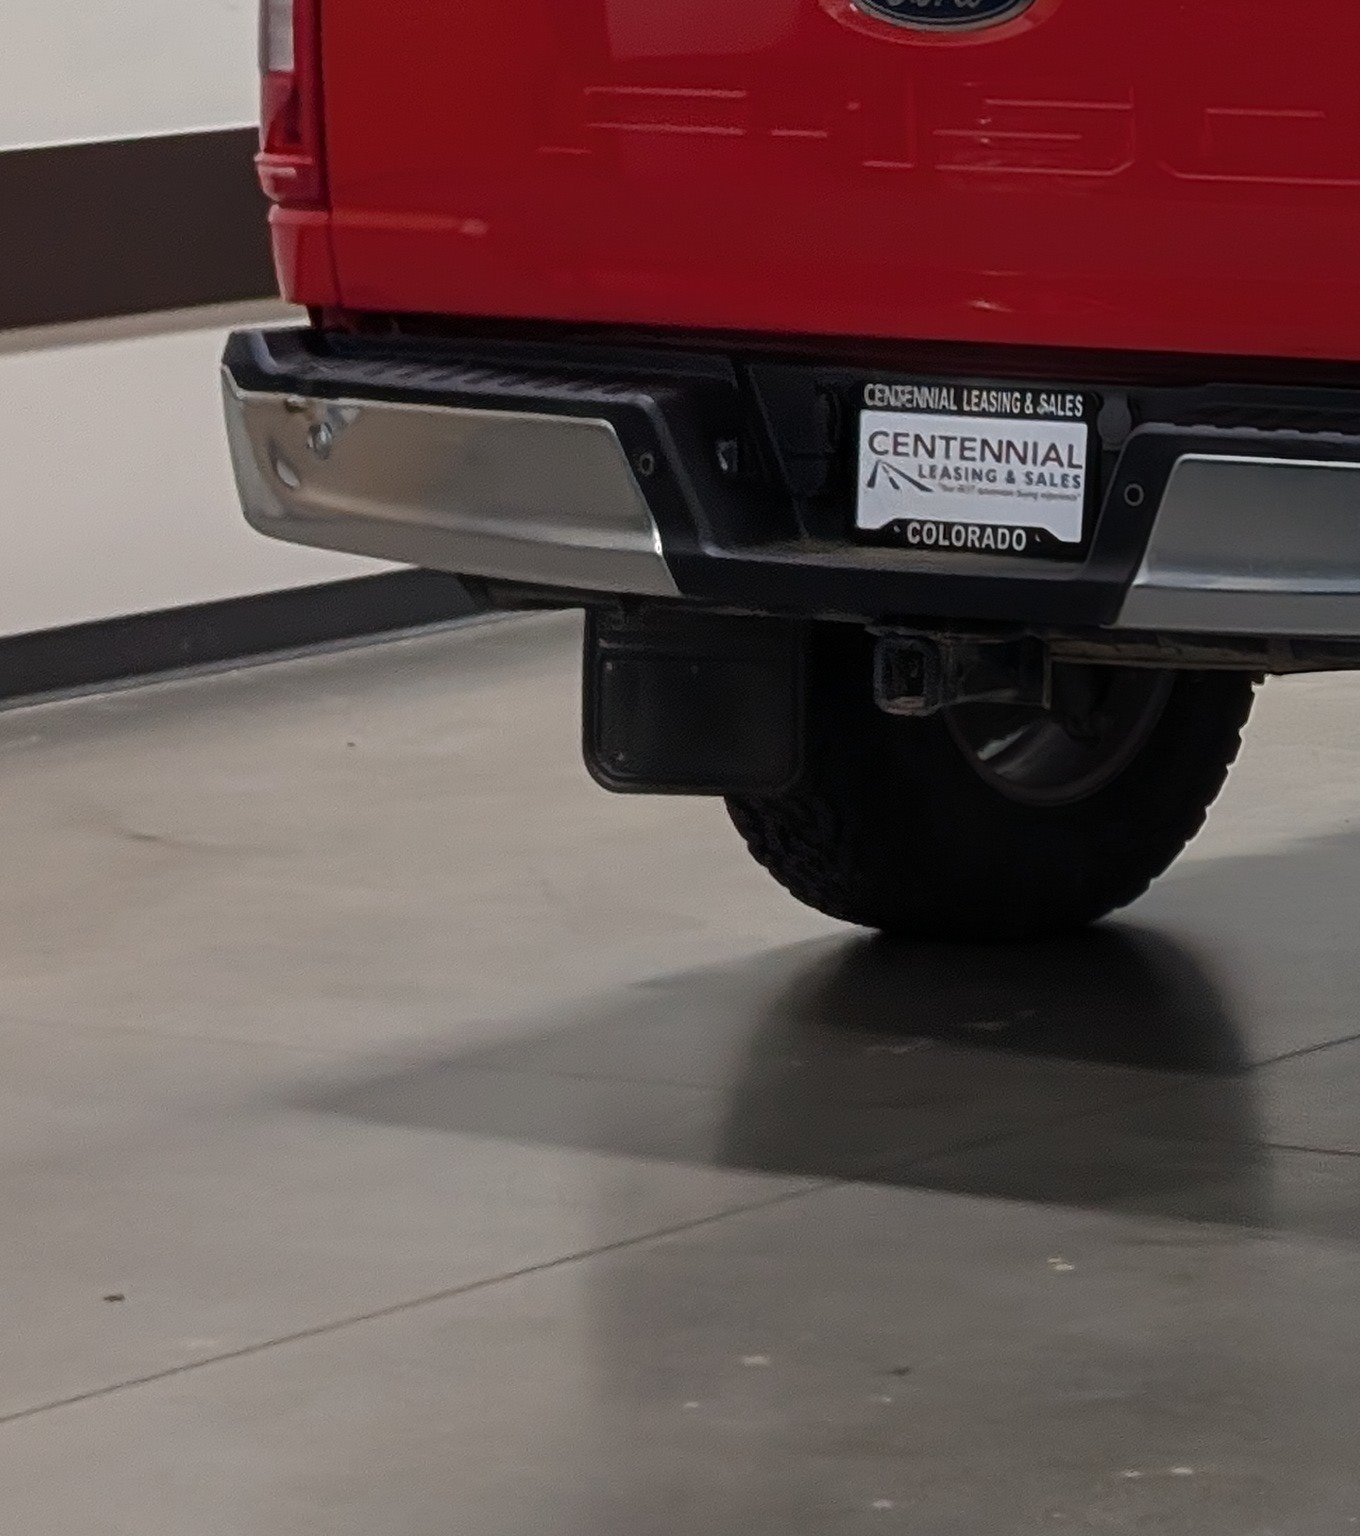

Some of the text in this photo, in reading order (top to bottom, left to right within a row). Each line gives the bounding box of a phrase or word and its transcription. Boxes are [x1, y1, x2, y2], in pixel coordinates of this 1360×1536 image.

[863, 383, 1084, 417] CENTENNIAL LEASING & SALES
[868, 430, 1083, 470] CENTENNIAL
[918, 464, 1082, 489] LEASING & SALES
[906, 521, 1027, 552] COLORADO
